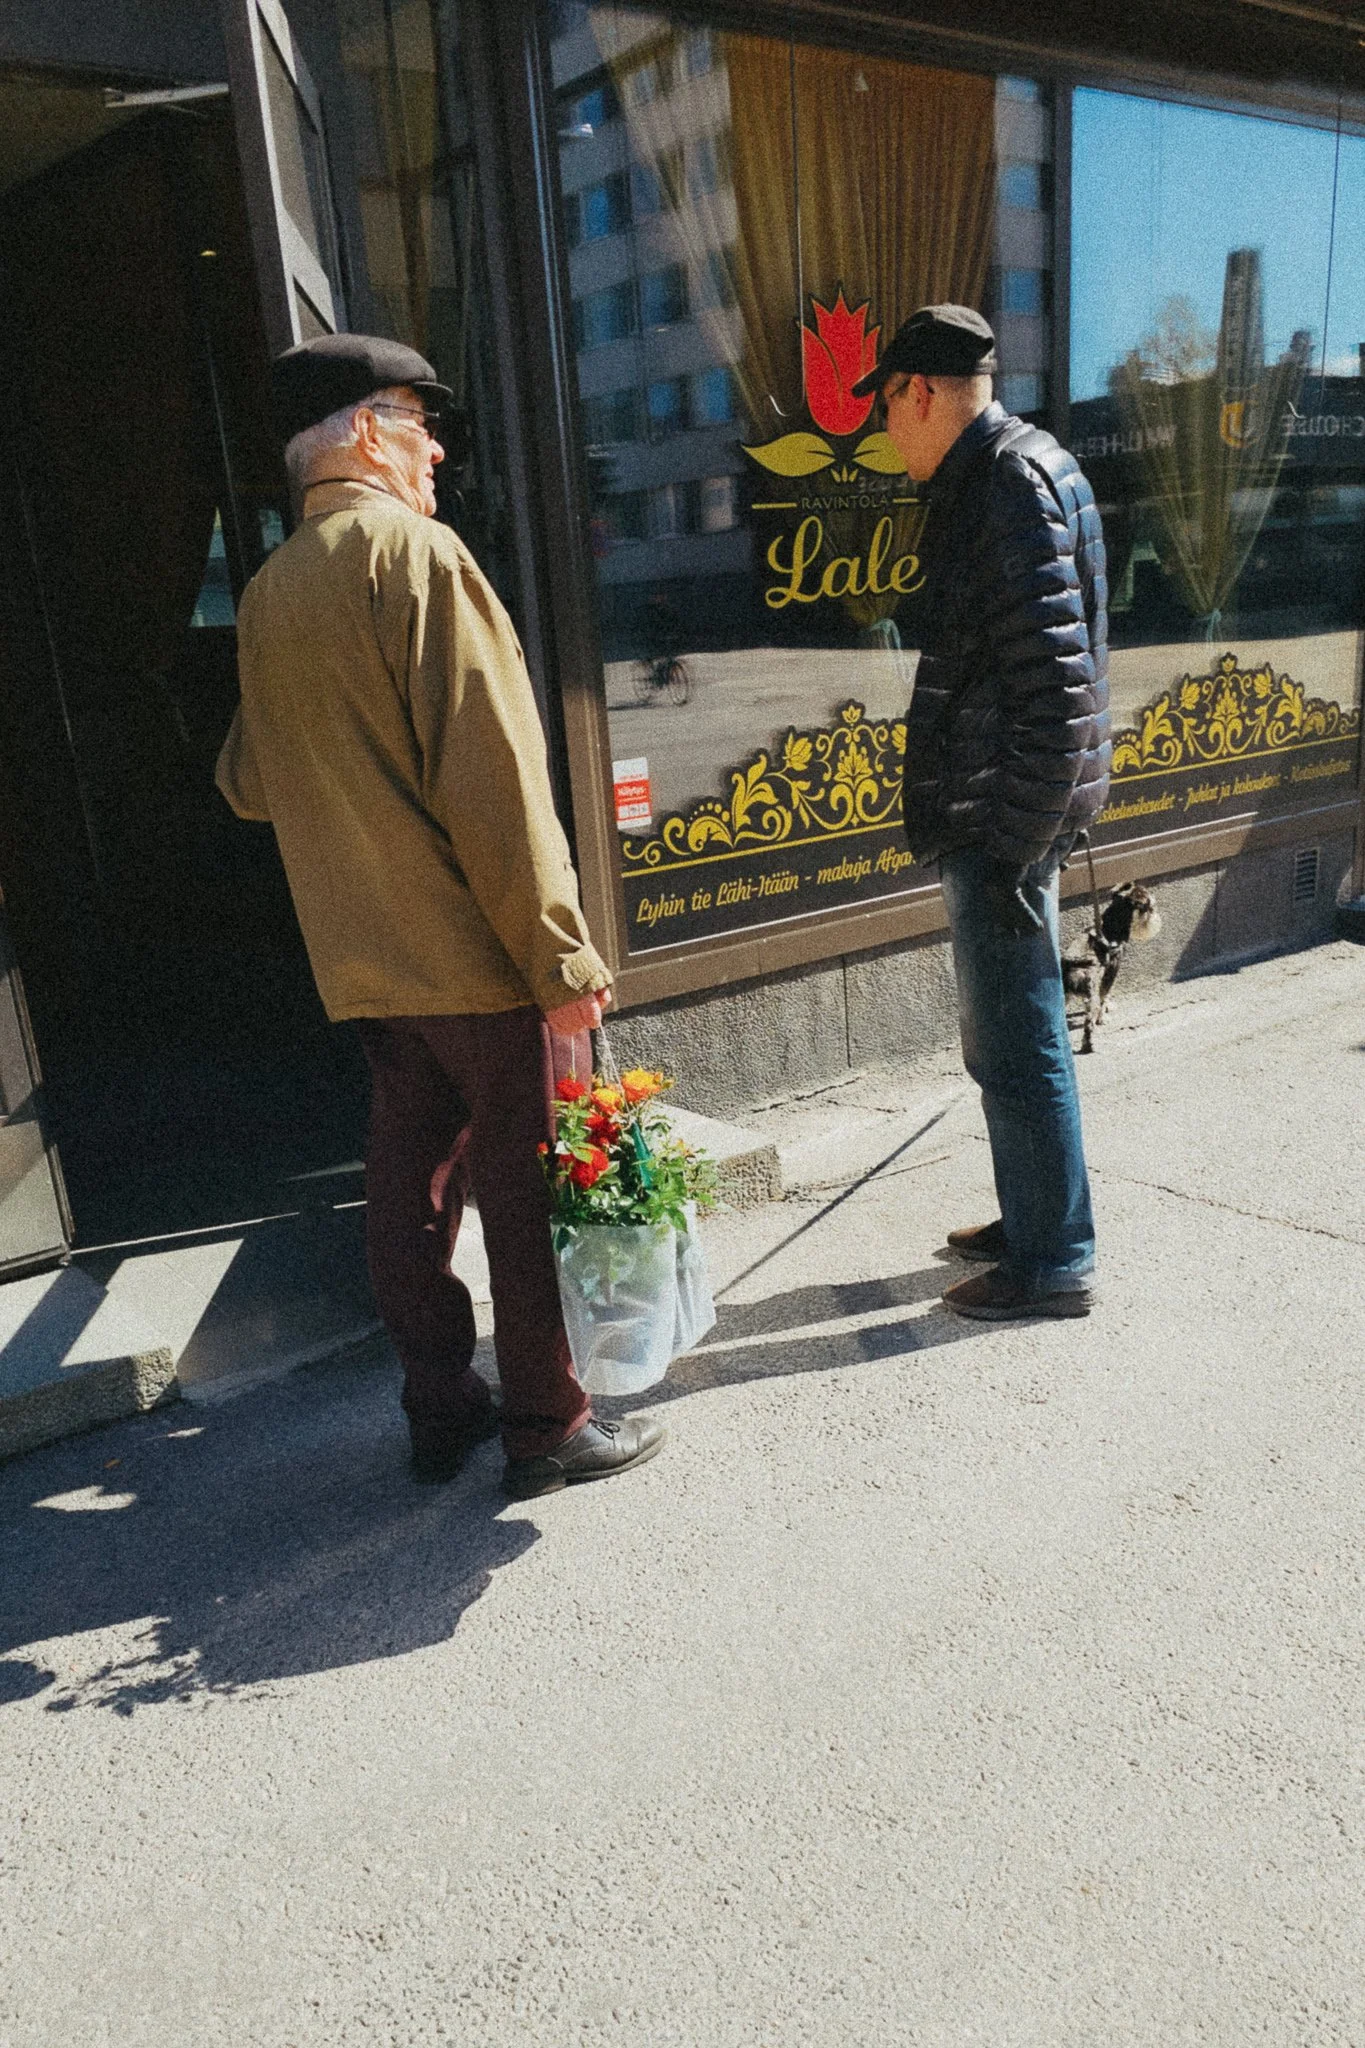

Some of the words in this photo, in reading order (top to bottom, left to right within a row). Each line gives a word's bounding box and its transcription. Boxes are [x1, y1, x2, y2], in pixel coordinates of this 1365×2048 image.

[801, 495, 888, 510] RAVINTOLA
[765, 515, 927, 609] Lale
[636, 893, 685, 928] Lyhin
[691, 887, 712, 911] tie
[716, 870, 799, 906] Lähi-Itään
[817, 855, 872, 885] makuja
